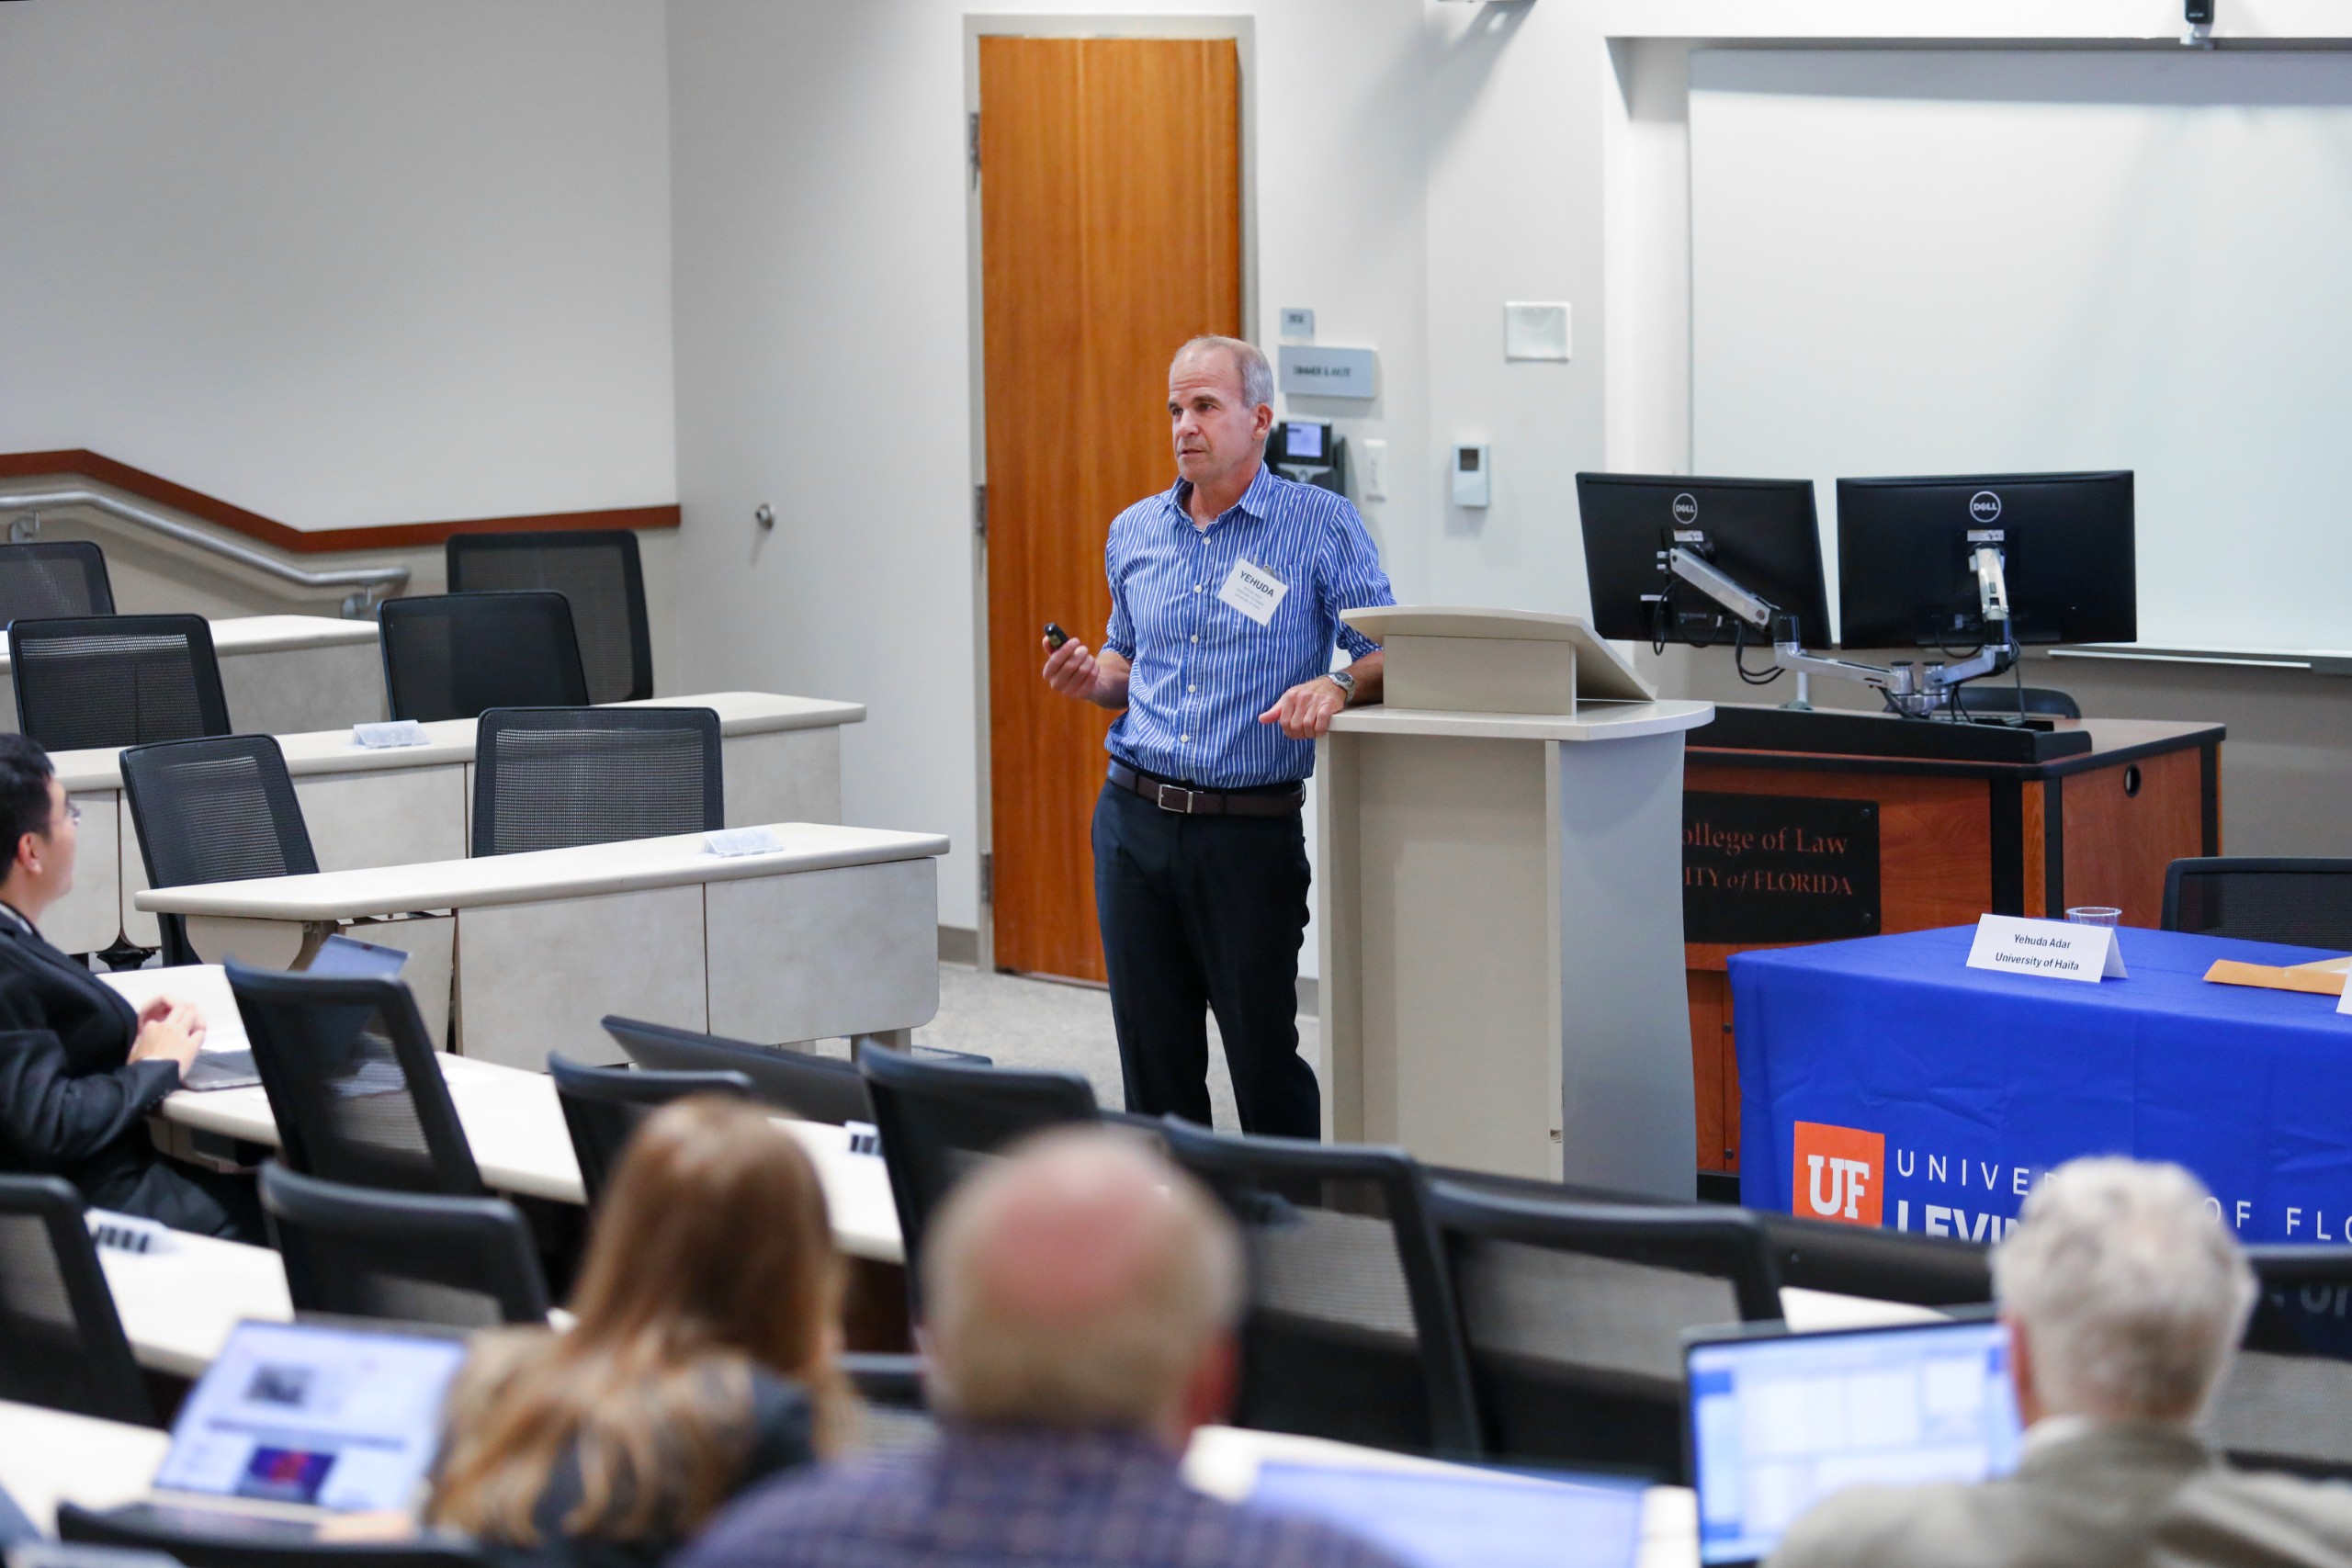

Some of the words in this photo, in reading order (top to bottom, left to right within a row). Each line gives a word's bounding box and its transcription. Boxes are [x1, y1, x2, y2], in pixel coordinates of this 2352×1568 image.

[1676, 504, 1695, 513] DELL
[1973, 502, 1997, 512] DELL
[1239, 570, 1274, 598] YEHUDA
[1682, 822, 1755, 856] ollege
[1762, 827, 1789, 852] of
[1796, 828, 1848, 854] Law
[1727, 869, 1750, 893] of
[1754, 871, 1853, 895] FLORIDA
[2015, 934, 2048, 947] Yehuda
[2049, 938, 2072, 949] Adar
[1996, 952, 2042, 968] University
[2043, 958, 2054, 967] of
[2054, 959, 2080, 971] Haifa
[1807, 1155, 1870, 1219] UF
